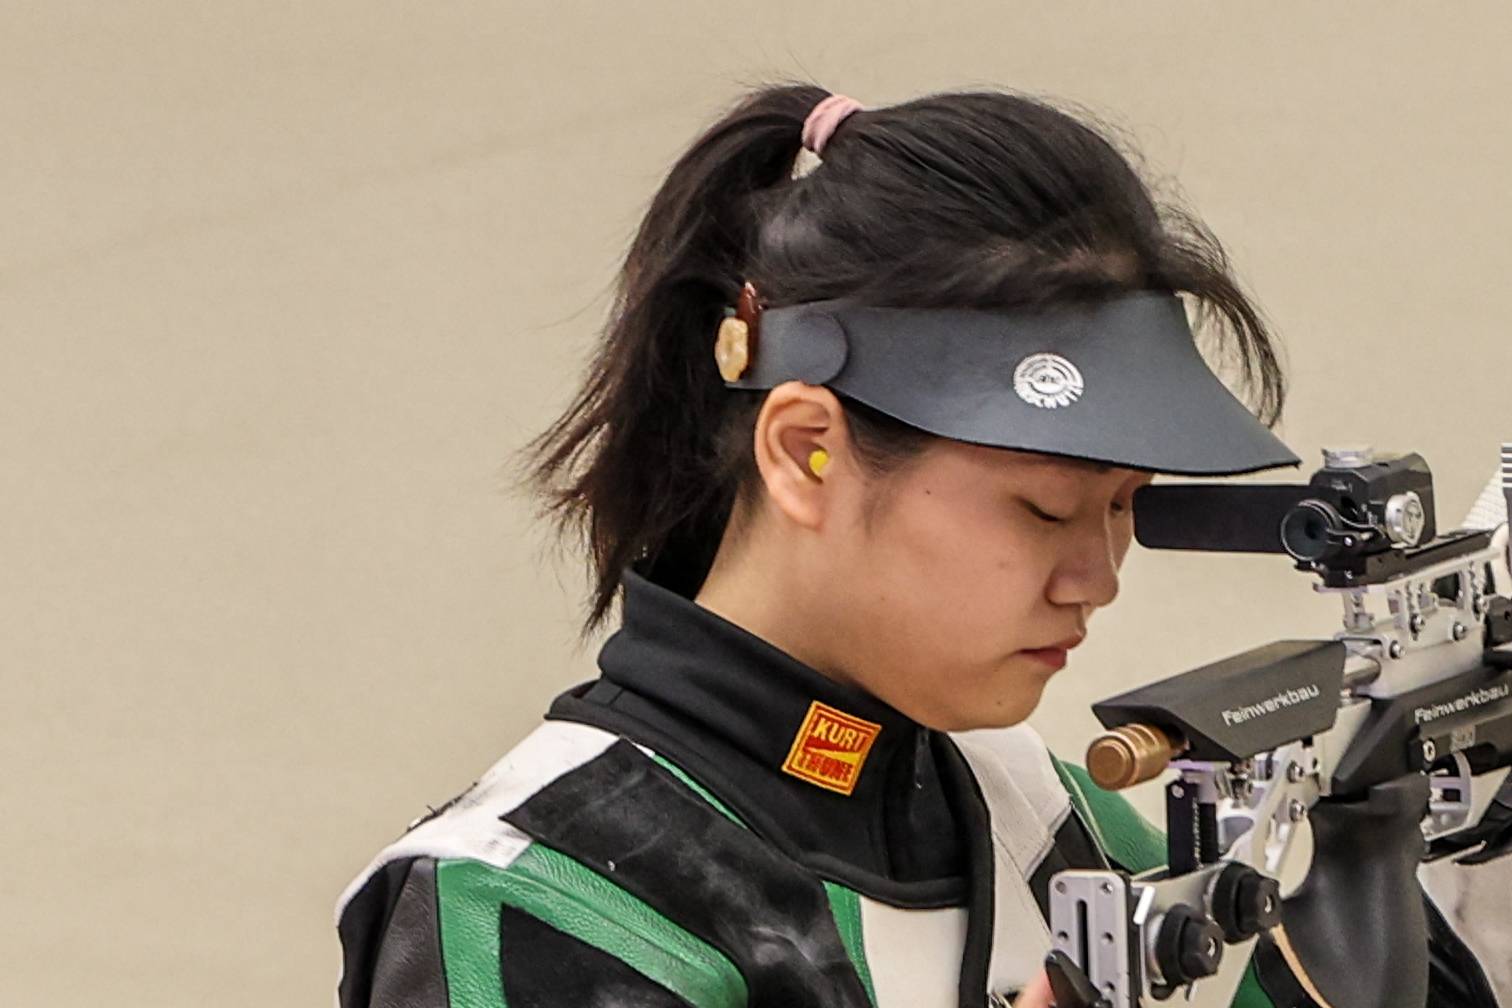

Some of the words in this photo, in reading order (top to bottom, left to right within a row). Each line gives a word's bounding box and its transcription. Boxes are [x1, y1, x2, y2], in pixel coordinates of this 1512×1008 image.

[1221, 684, 1320, 727] Feinwerkbau
[1414, 684, 1510, 725] Feinwerkbau
[812, 717, 870, 752] KURT
